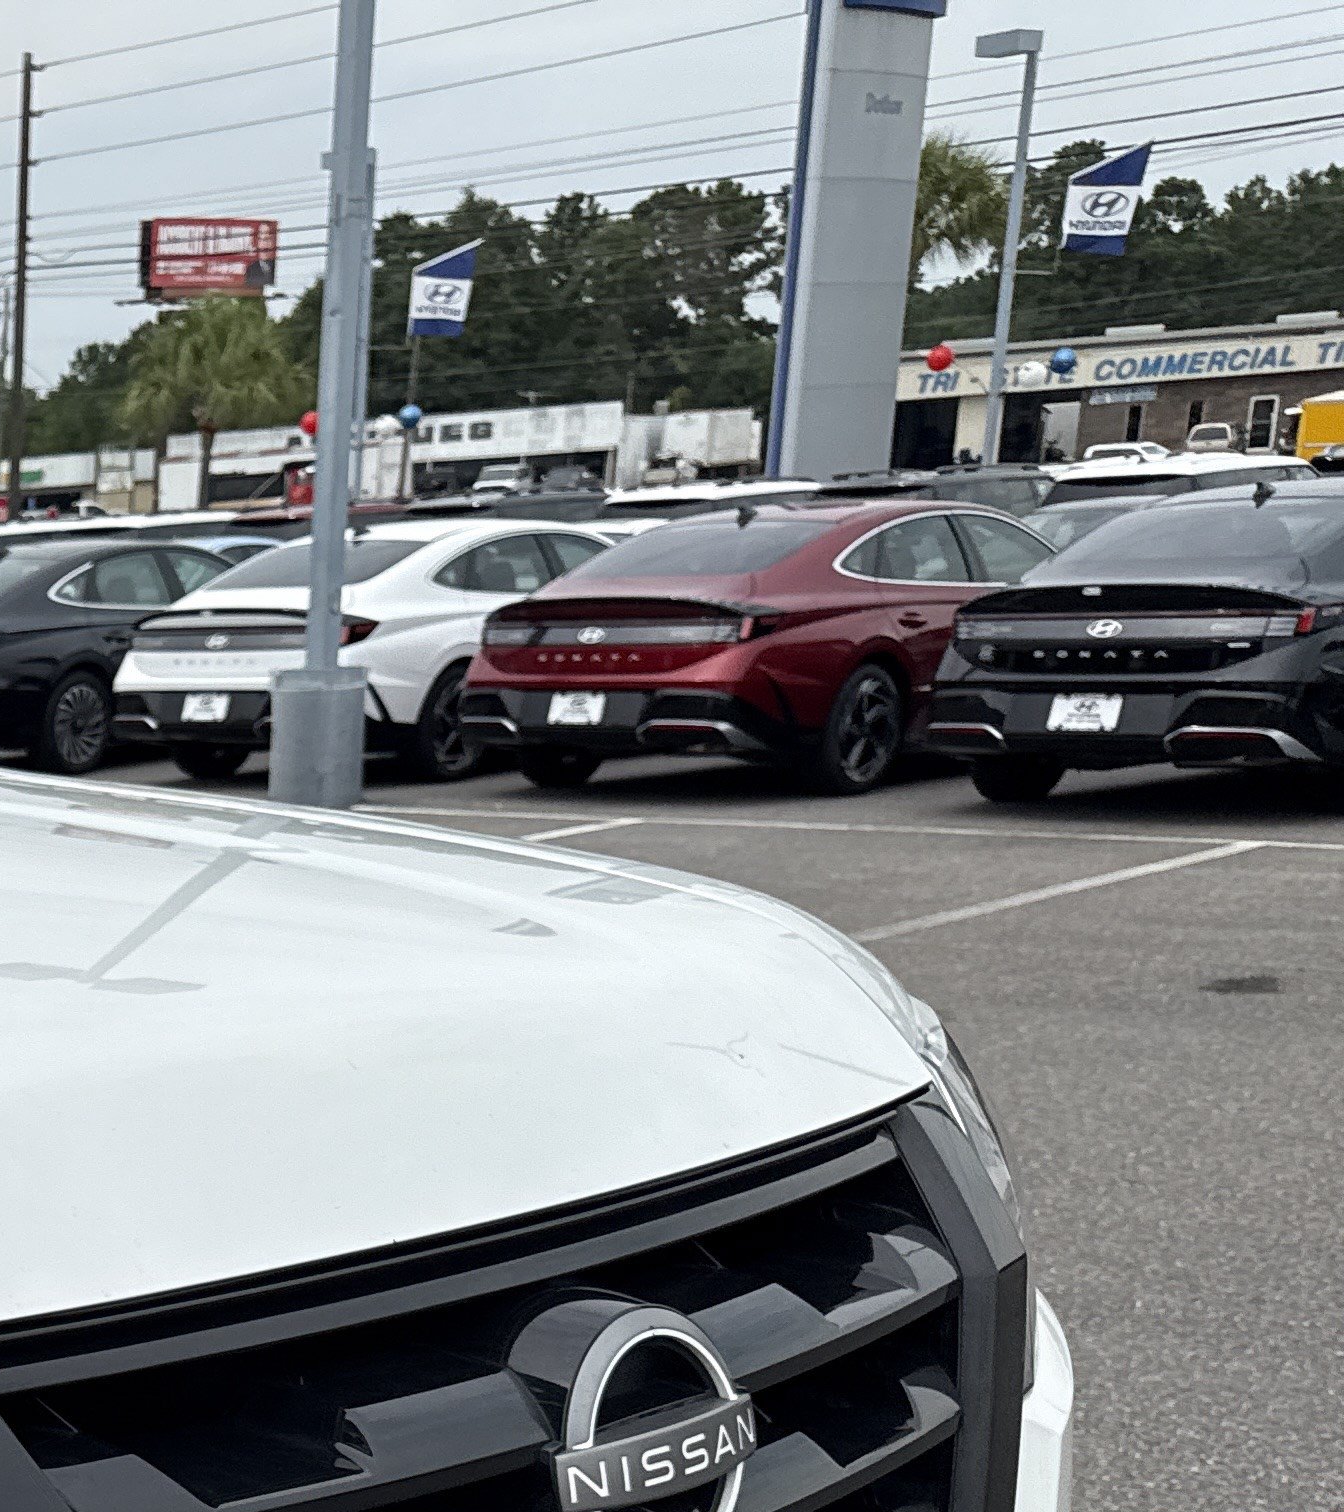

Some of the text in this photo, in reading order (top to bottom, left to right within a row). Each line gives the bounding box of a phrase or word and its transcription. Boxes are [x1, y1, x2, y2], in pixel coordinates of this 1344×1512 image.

[918, 371, 960, 394] TRI
[1094, 345, 1297, 383] COMMERCIAL
[1032, 649, 1169, 660] SONATA
[566, 1407, 756, 1504] NISSAN
